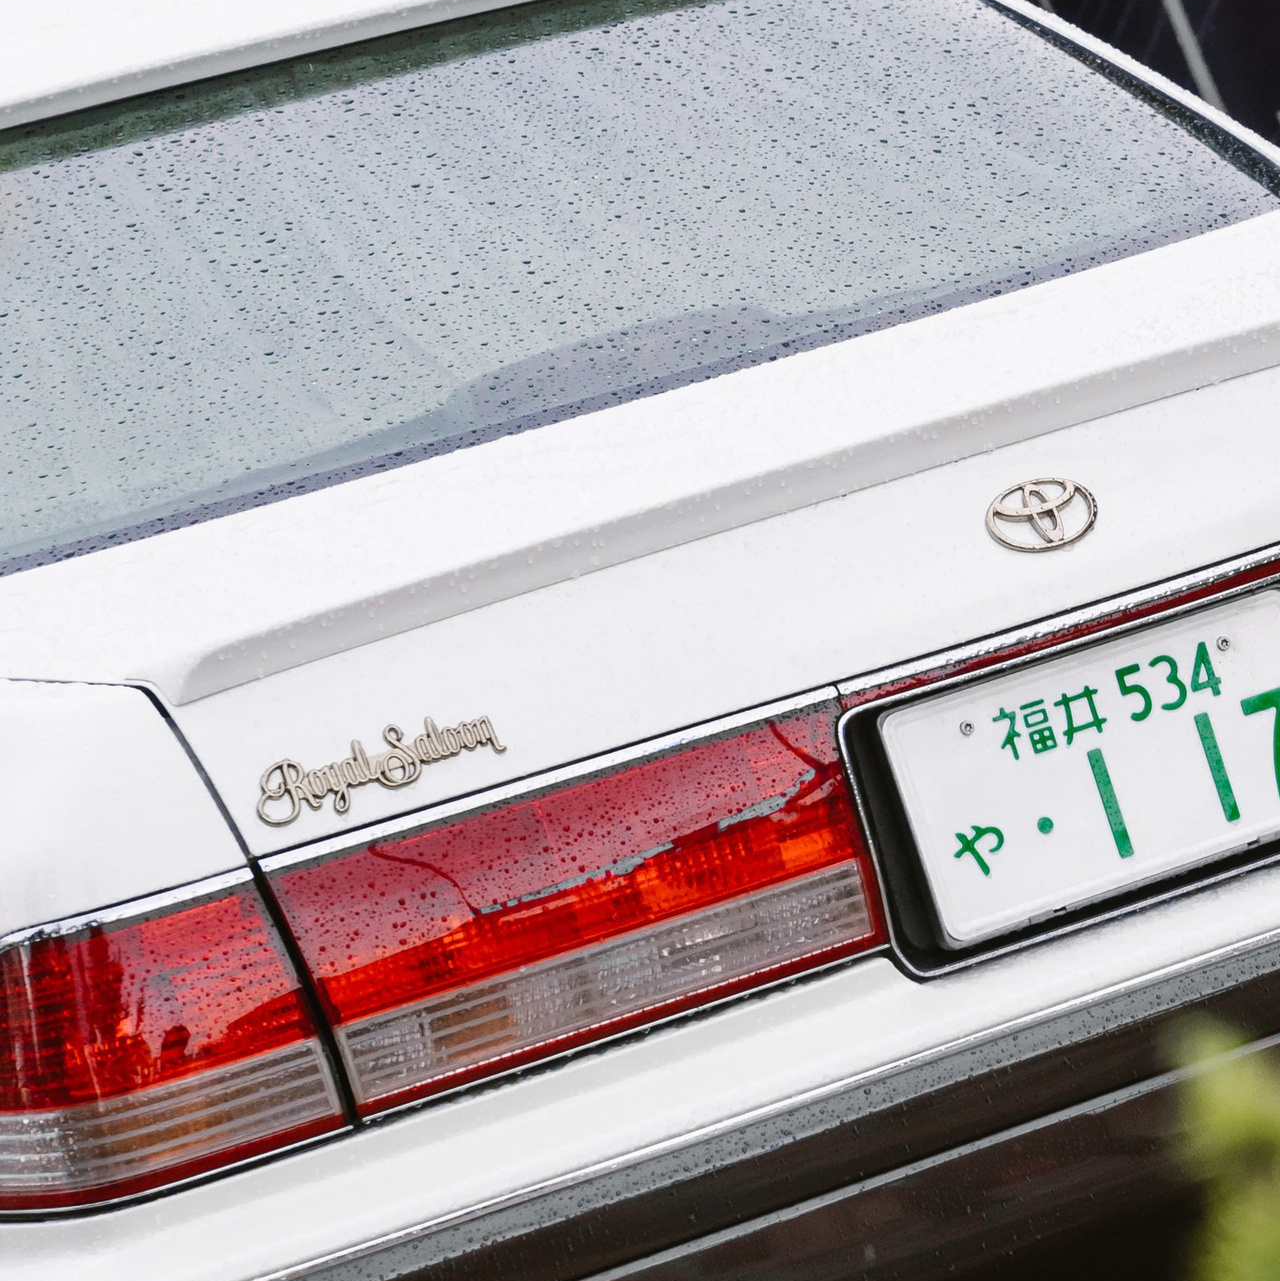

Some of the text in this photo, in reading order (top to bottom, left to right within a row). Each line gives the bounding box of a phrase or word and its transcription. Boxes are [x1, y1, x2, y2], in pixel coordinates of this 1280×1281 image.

[992, 640, 1222, 760] 福井 534
[256, 714, 507, 827] Royal Saloon
[953, 824, 1005, 877] や
